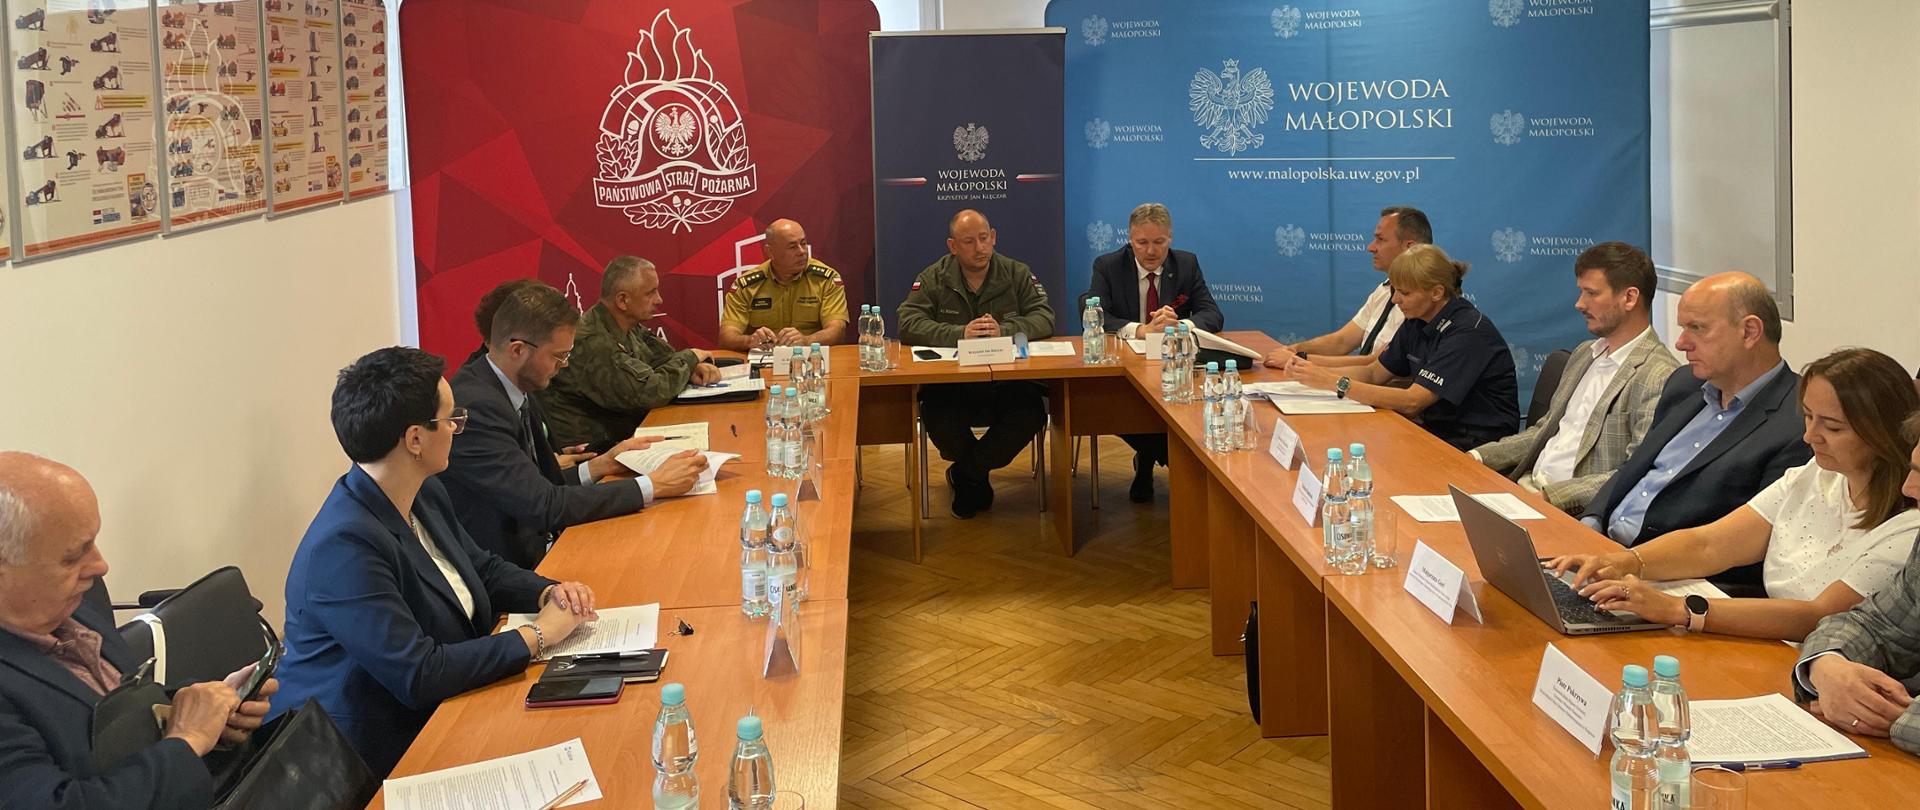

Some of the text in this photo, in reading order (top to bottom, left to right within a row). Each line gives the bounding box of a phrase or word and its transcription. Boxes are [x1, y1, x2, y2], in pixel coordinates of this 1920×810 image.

[1306, 9, 1361, 20] WOJEWODA
[1112, 20, 1159, 29] WOJEWODA
[1288, 79, 1449, 104] WOJEWODA
[1285, 108, 1454, 131] MAŁOPOLSKI
[1530, 117, 1593, 127] WOJEWODA
[1114, 125, 1162, 133] WOJEWODA
[938, 168, 1005, 180] WOJEWODA
[1228, 166, 1420, 185] www.malopolska.uw.gov.pl
[600, 170, 750, 202] PAŃSTWOWA STRAŻ POŻARNA
[936, 180, 1007, 192] MAŁOPOLSKI
[1310, 233, 1364, 242] WOJEWODA
[1532, 236, 1594, 246] WOJEWODA
[1211, 283, 1262, 293] WOJEWODA
[1418, 368, 1445, 386] POLICJA
